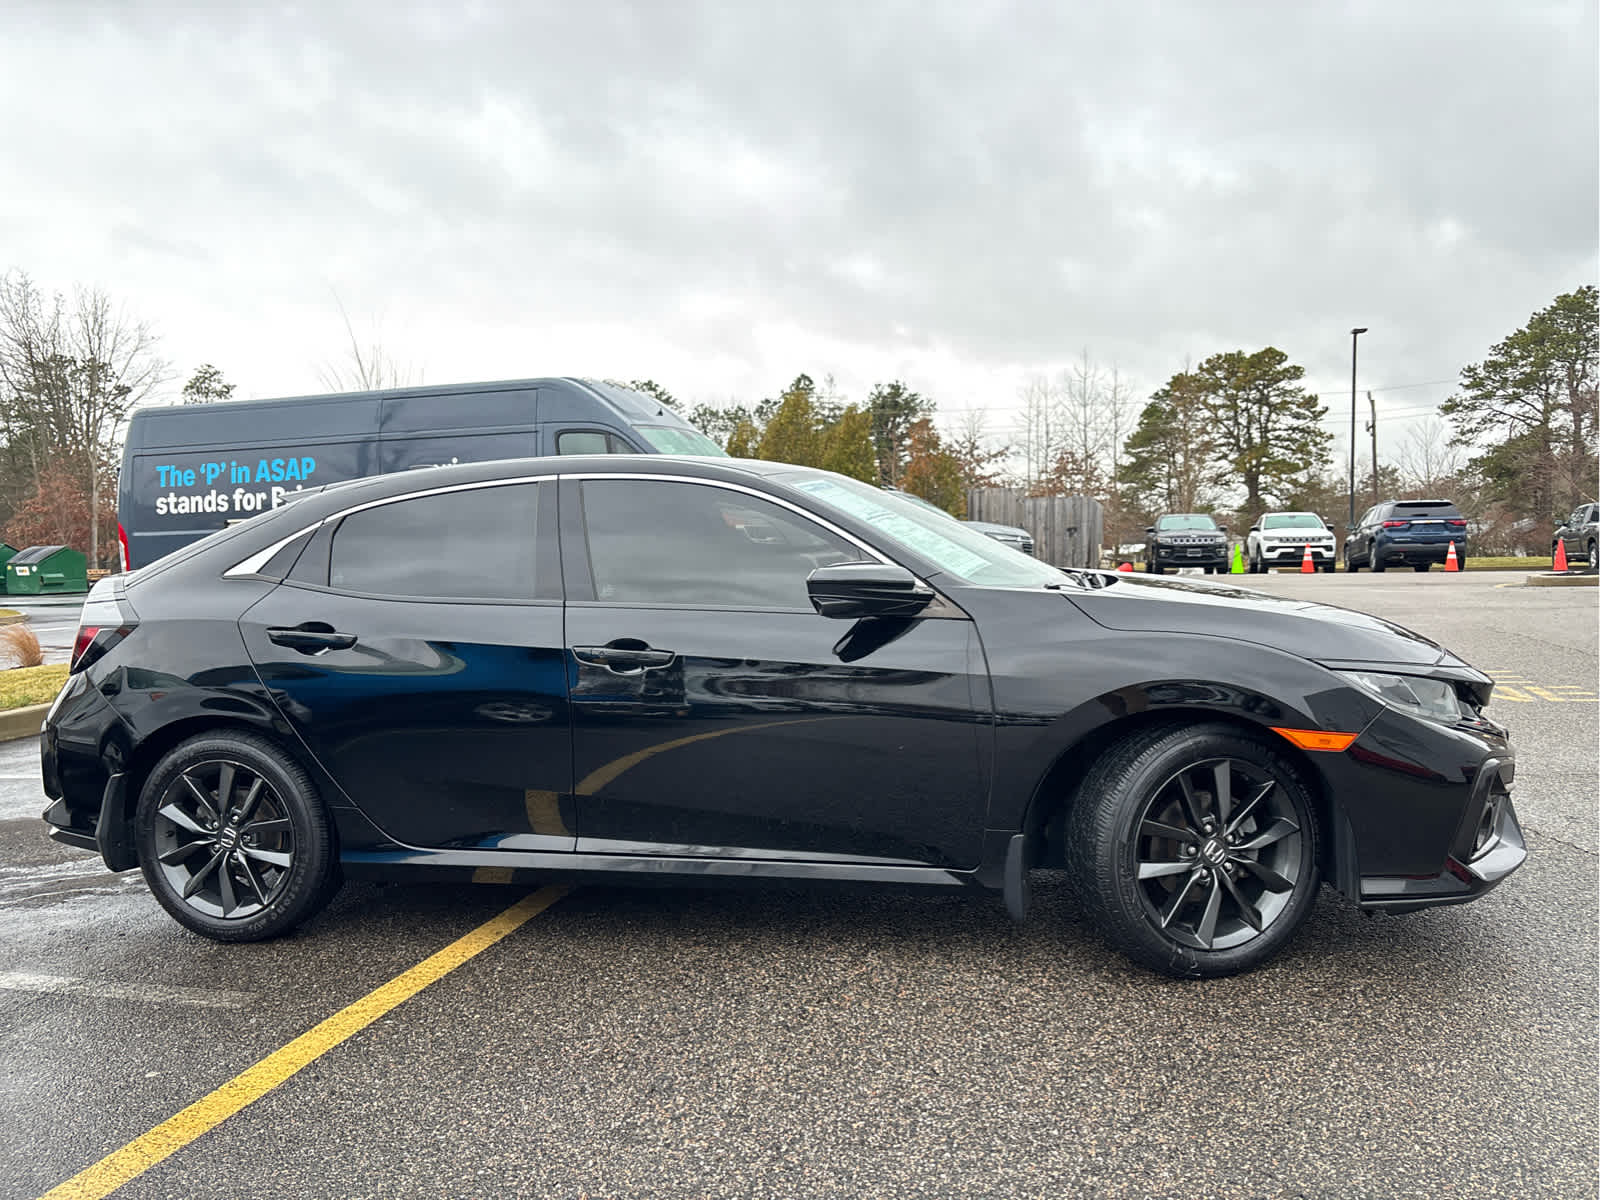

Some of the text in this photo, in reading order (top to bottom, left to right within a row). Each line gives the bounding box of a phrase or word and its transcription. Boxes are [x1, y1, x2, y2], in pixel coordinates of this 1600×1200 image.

[156, 465, 195, 487] The
[230, 461, 250, 484] in
[254, 457, 316, 483] ASAP
[156, 489, 229, 515] stands
[233, 488, 267, 512] for
